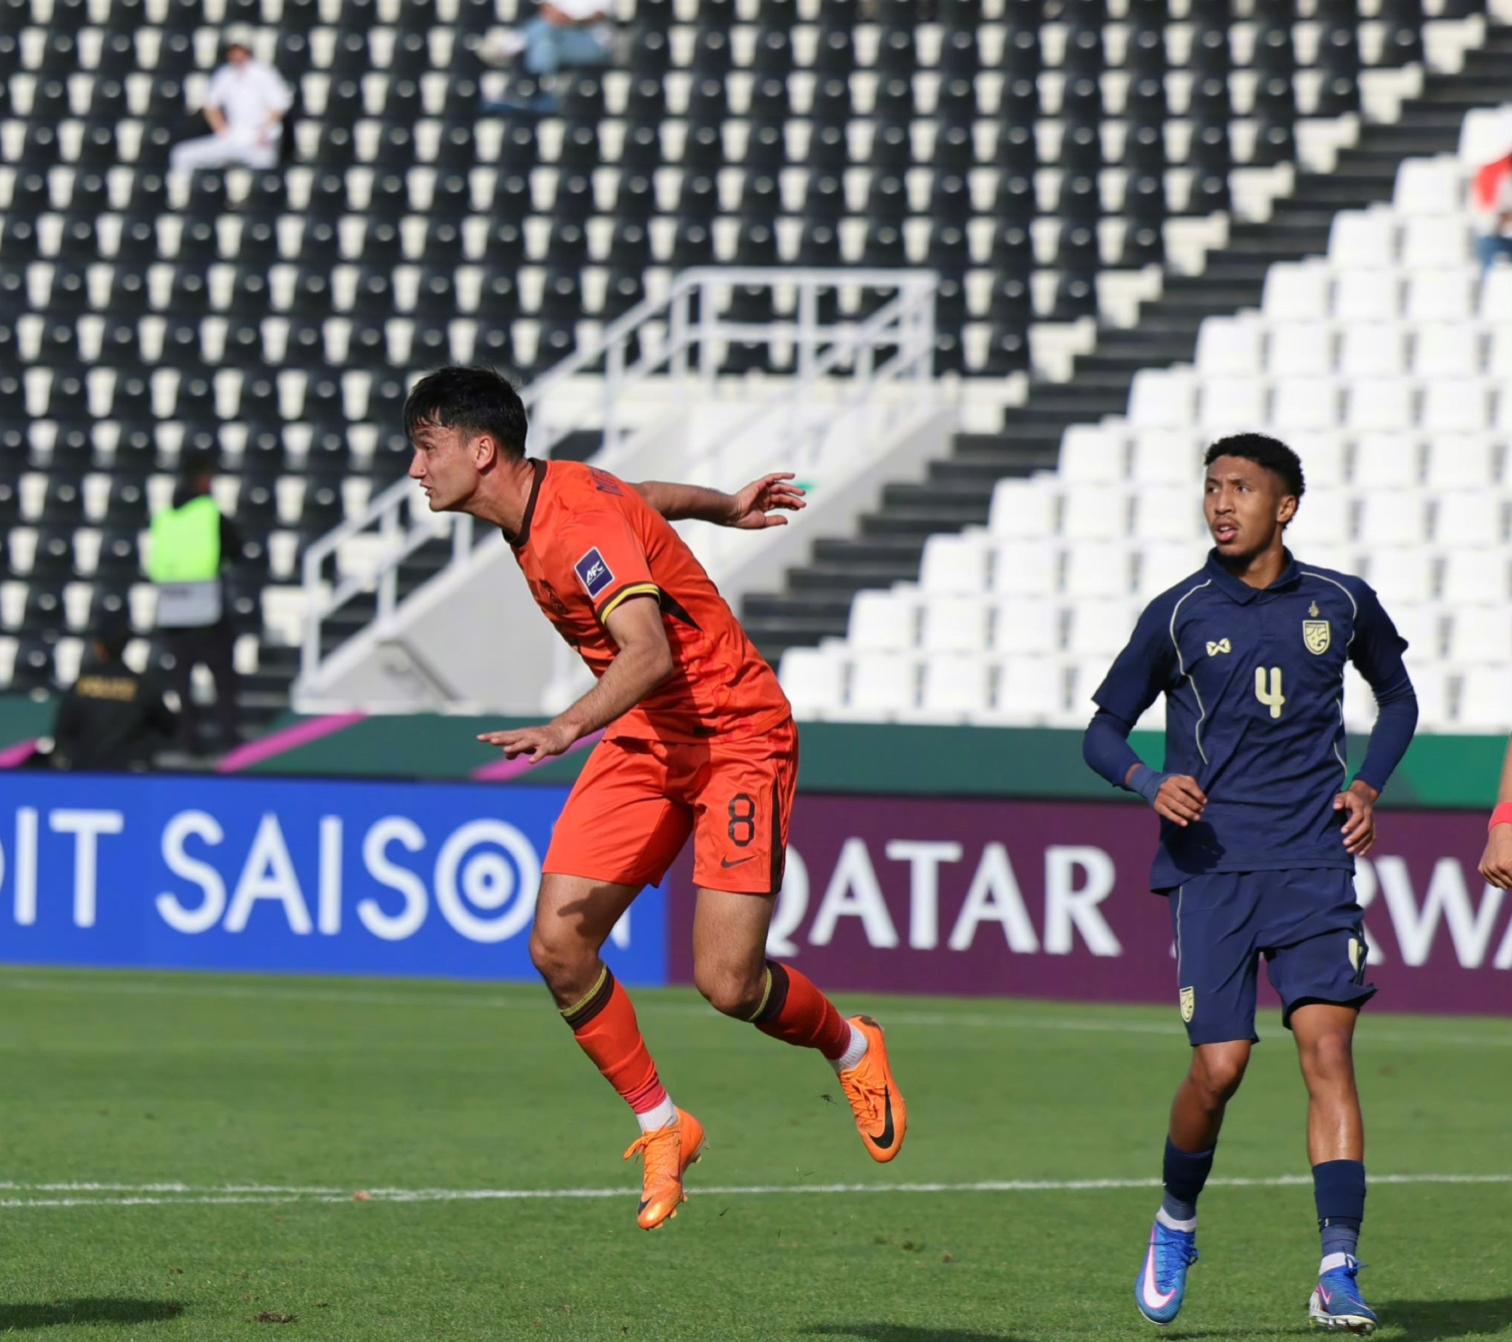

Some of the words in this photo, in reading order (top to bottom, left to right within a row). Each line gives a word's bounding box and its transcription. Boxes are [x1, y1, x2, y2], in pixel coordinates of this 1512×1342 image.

[586, 561, 605, 584] AFC
[1255, 666, 1286, 719] 4
[727, 792, 757, 848] 8
[154, 809, 632, 951] SAISO
